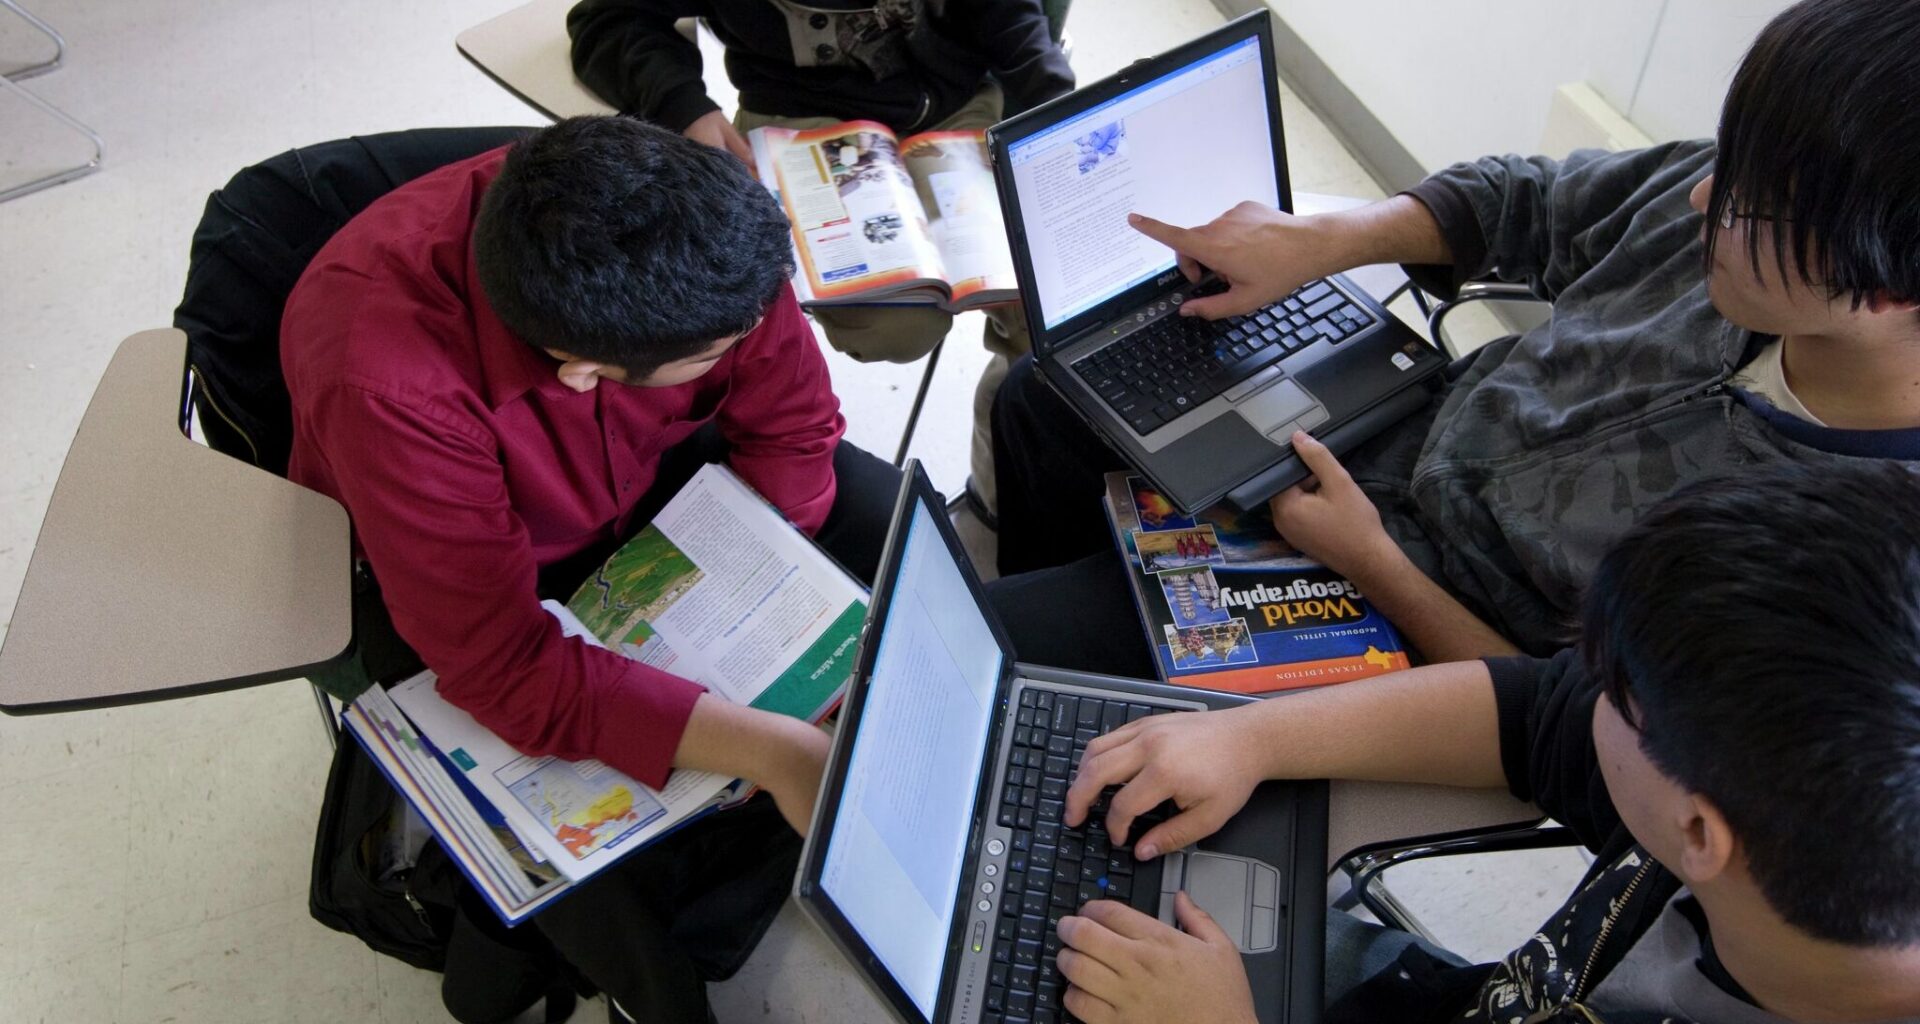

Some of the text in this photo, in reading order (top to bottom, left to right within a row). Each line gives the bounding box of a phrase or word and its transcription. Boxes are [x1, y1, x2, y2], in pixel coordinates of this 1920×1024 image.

[1220, 579, 1363, 609] Geography
[1260, 598, 1361, 627] World
[1293, 626, 1377, 641] McDOUGAL LITTELL
[810, 634, 857, 680] North Africa
[1276, 665, 1364, 680] TEXAS EDITION
[960, 984, 973, 1024] TITUDE
